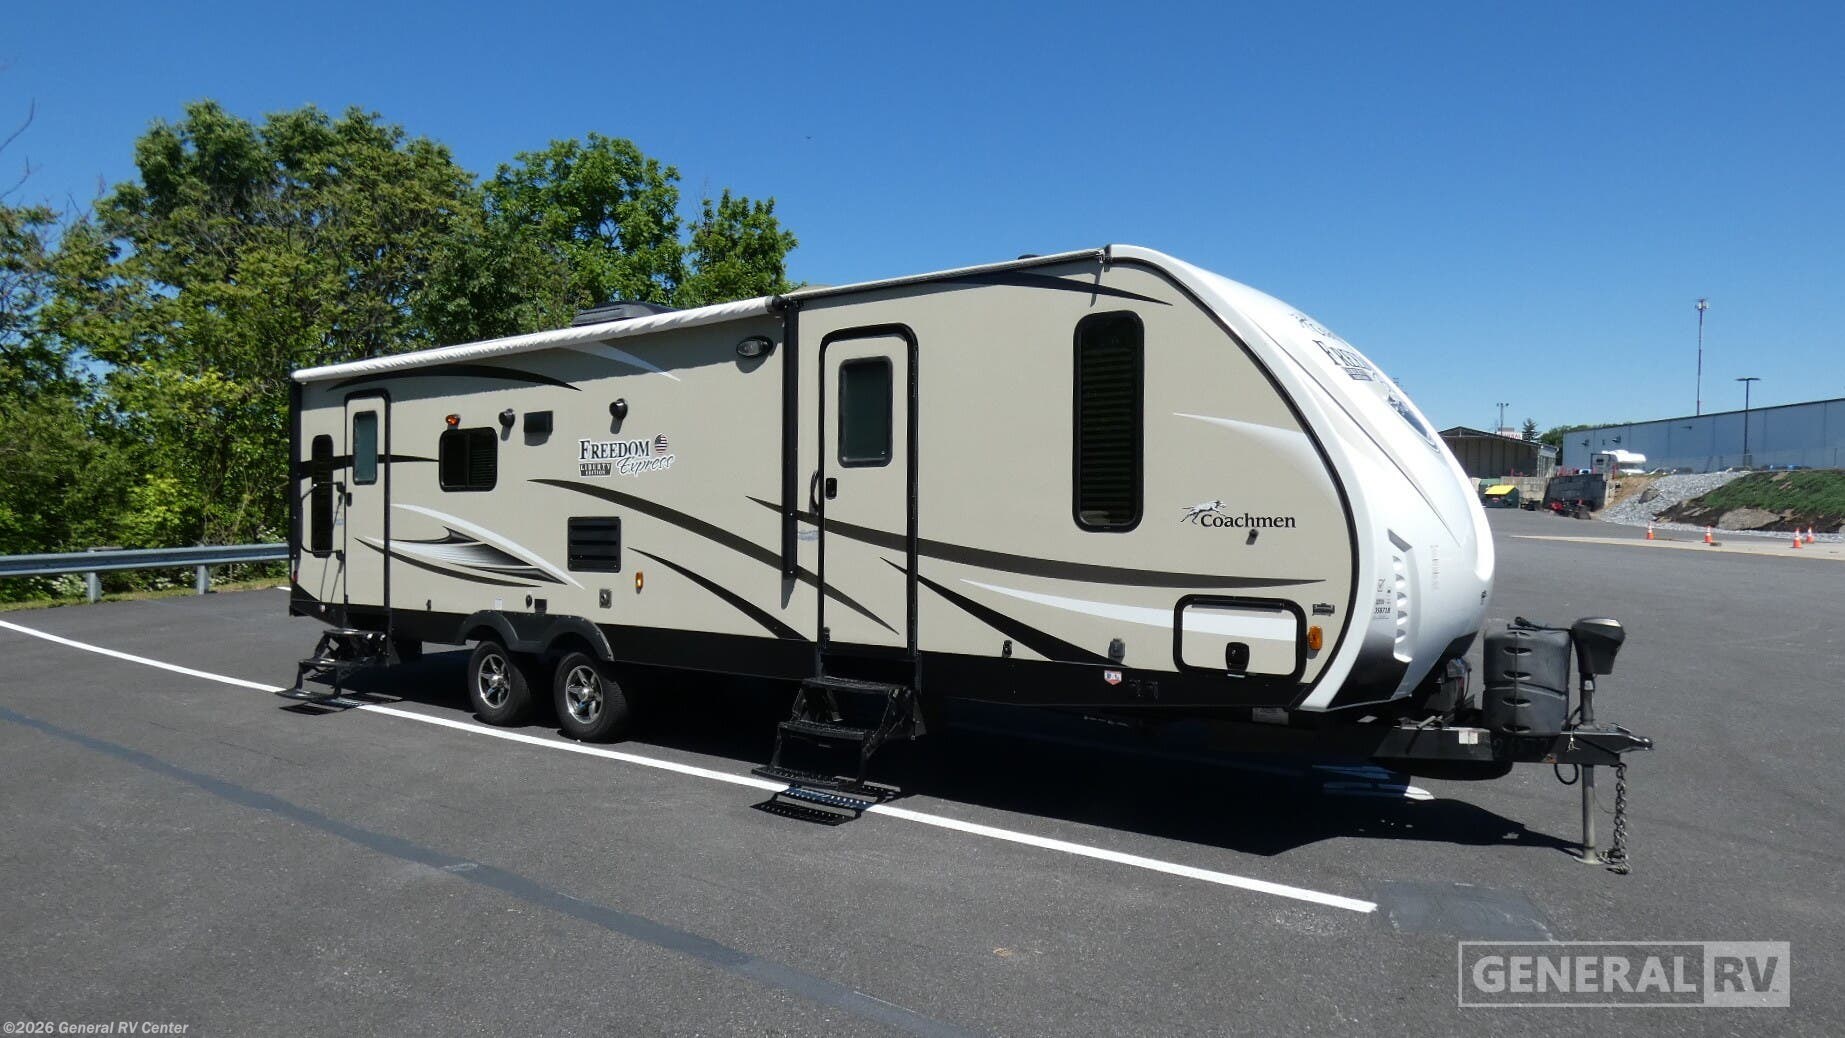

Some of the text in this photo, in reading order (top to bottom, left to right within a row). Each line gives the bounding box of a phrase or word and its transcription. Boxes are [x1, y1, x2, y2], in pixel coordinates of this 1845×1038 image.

[580, 439, 650, 460] FREEDOM
[580, 463, 611, 471] LIBERTY
[616, 455, 674, 475] Express
[1200, 512, 1297, 528] Coachmen
